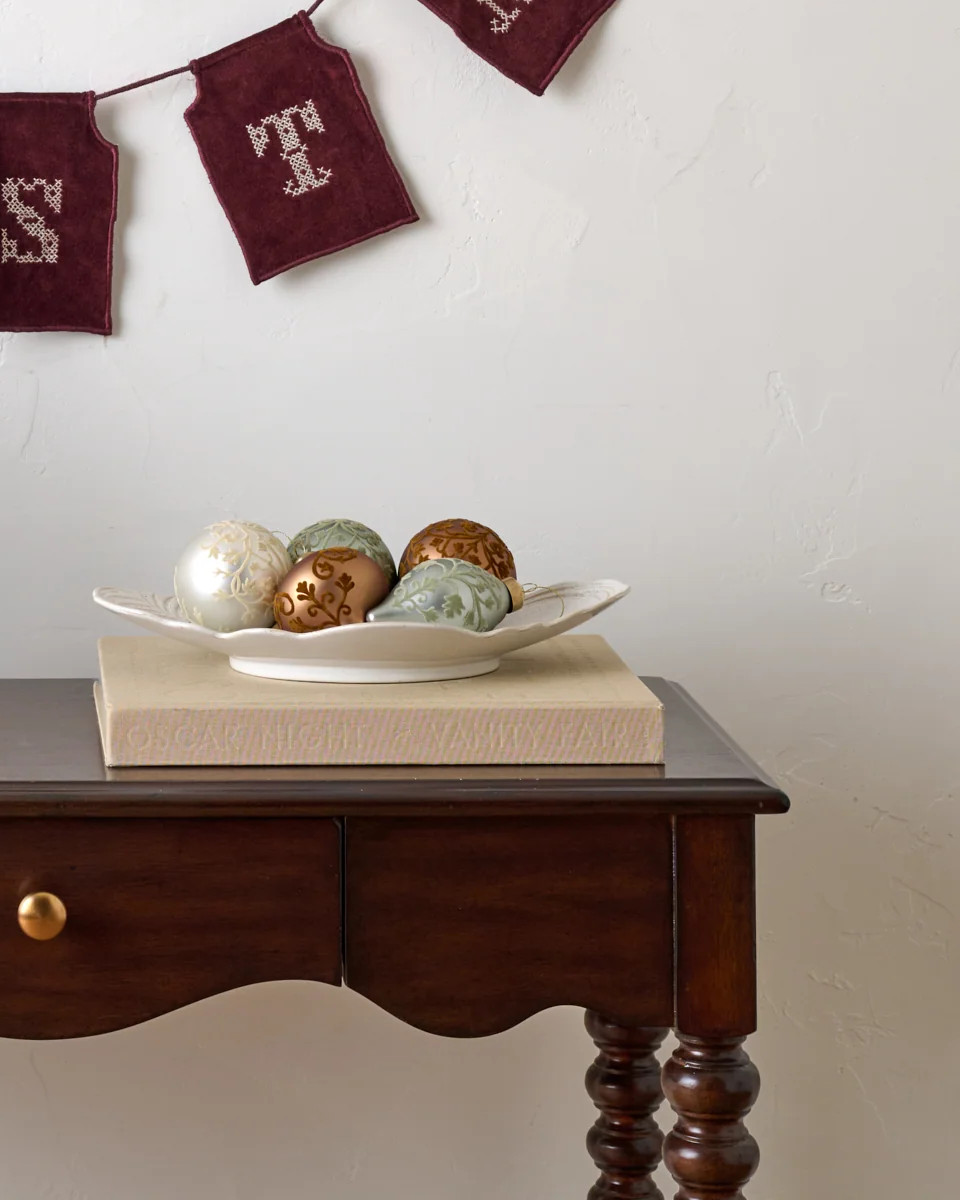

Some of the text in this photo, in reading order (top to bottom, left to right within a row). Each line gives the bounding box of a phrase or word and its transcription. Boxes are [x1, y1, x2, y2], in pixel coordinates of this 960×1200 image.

[127, 723, 242, 750] OSCAR
[260, 723, 368, 750] NIGHT
[431, 721, 544, 749] VANITY
[558, 721, 631, 749] FAIR
